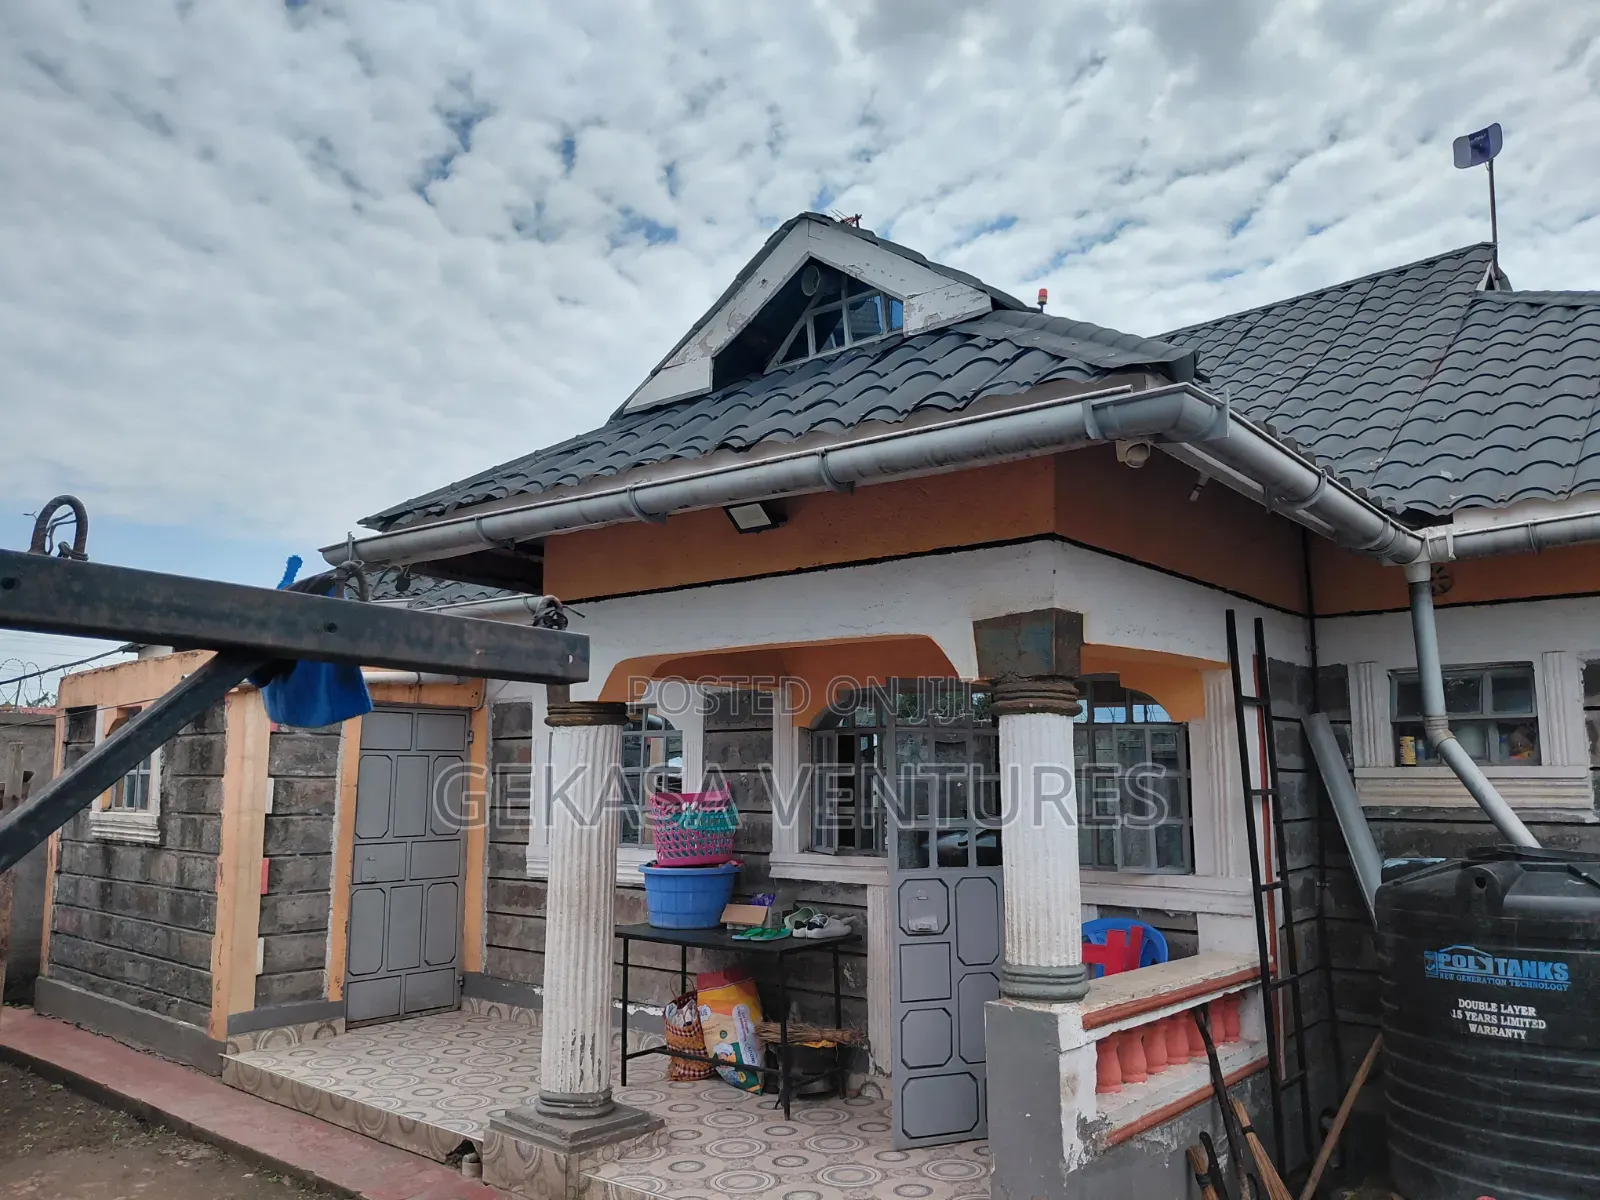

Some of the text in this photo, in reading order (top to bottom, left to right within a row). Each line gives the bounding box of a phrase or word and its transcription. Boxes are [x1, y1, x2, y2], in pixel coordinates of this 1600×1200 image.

[1438, 953, 1569, 980] POLYTANKS
[1439, 971, 1569, 991] NEW GENERATION TECHNOLOGY
[1458, 998, 1537, 1016] DOUBLE LAYER
[1452, 1009, 1547, 1029] 15 YEARS LIMITED
[1469, 1023, 1526, 1039] WARRANTY
